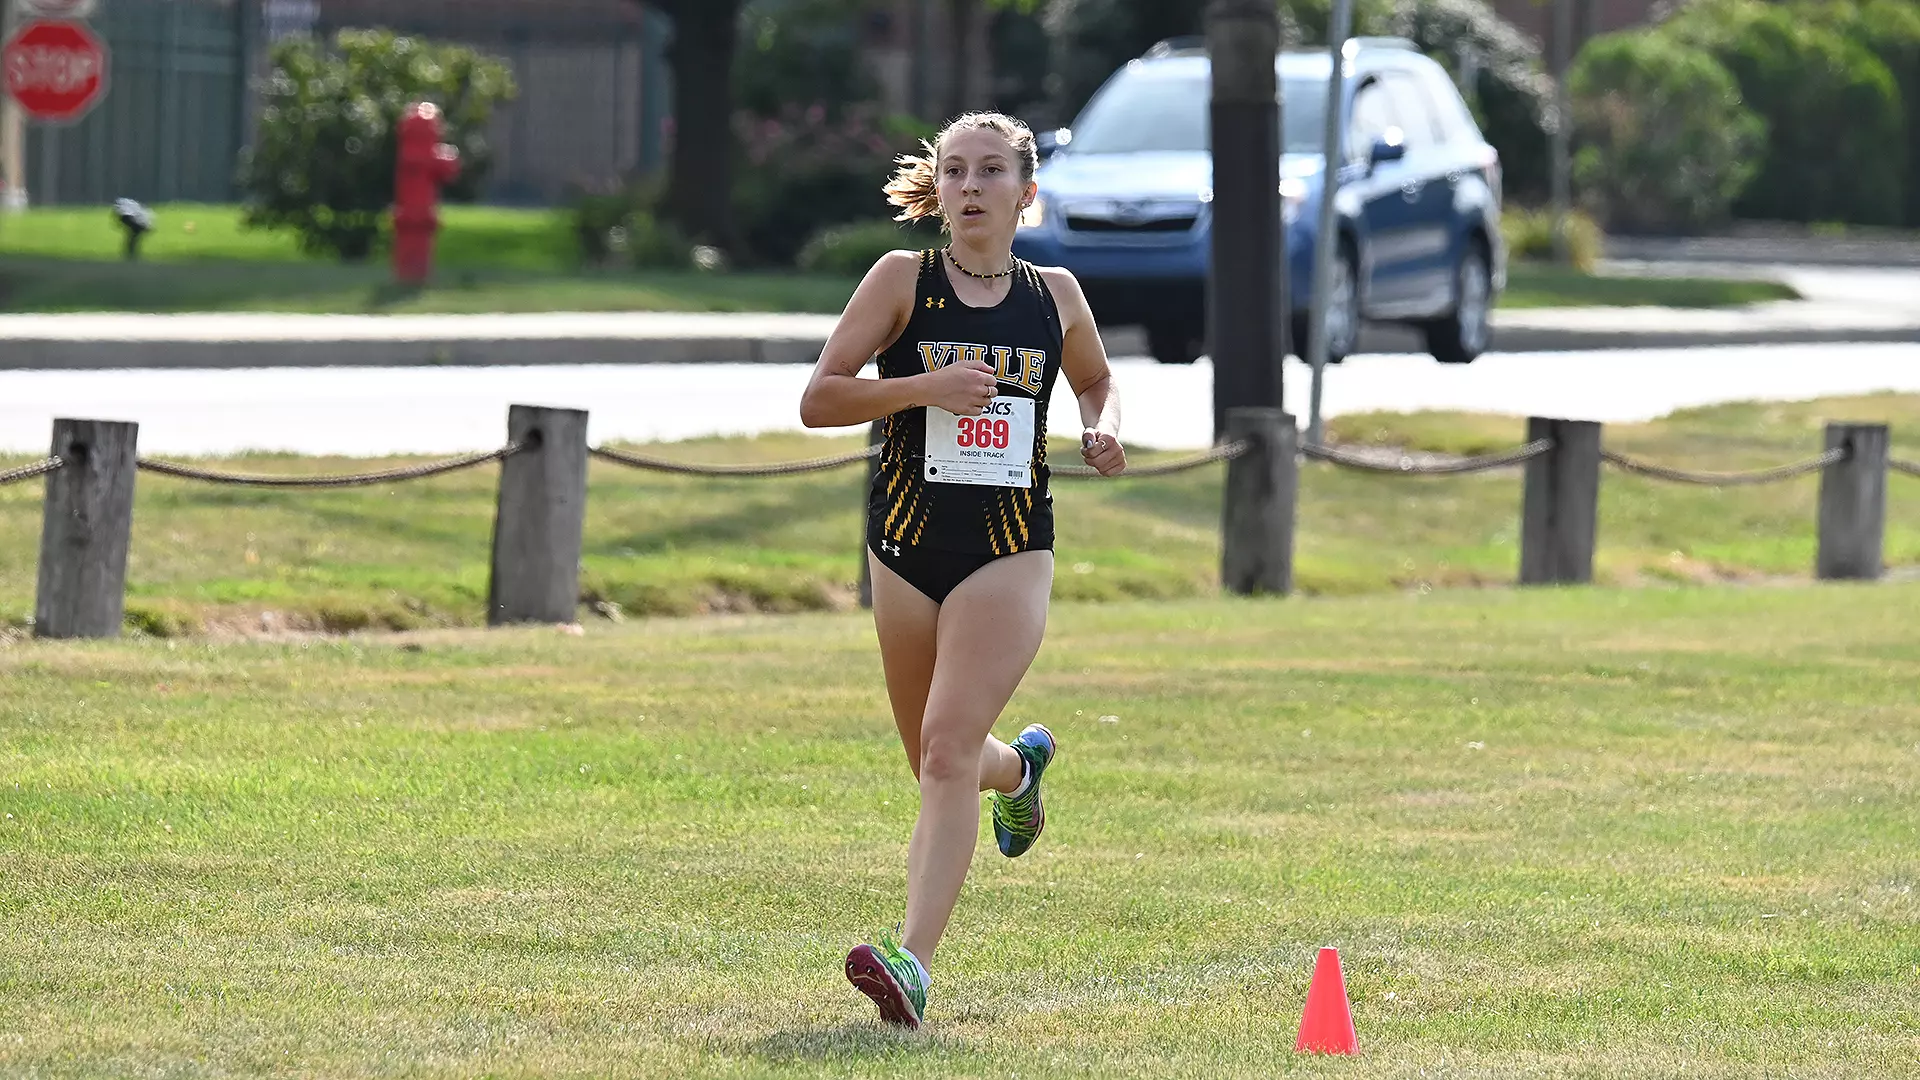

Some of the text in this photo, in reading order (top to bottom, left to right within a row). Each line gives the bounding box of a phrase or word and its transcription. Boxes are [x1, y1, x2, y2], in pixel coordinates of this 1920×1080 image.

[6, 46, 93, 91] STOP
[981, 402, 1012, 415] SICS
[957, 417, 1010, 449] 369
[959, 450, 1005, 459] INSIDE TRACK
